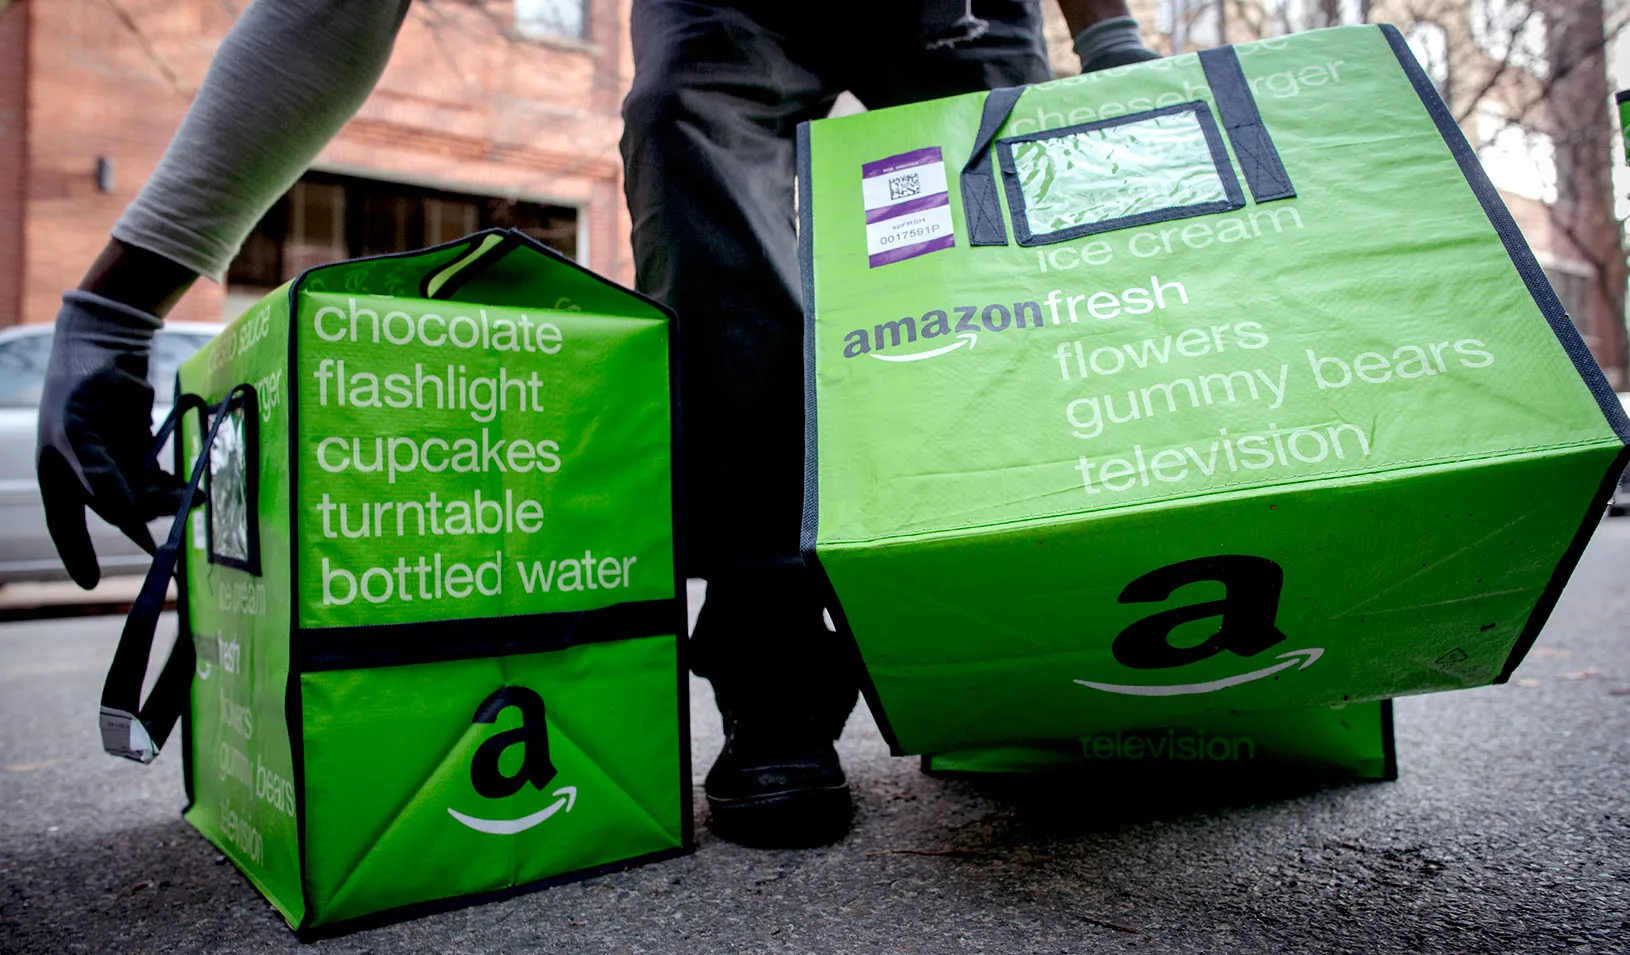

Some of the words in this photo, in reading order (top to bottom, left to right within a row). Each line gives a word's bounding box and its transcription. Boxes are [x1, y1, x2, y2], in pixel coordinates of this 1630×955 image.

[1009, 58, 1344, 137] cheesebrger
[880, 224, 941, 246] 0017591P
[1036, 239, 1113, 273] ice
[1129, 204, 1304, 258] cream
[313, 298, 563, 356] chocolate
[1053, 320, 1270, 382] flowers
[313, 358, 544, 423] flashlight
[1065, 367, 1290, 441] gummy
[1305, 338, 1496, 391] bears
[315, 427, 562, 484] cupcakes
[1074, 424, 1371, 496] television
[315, 488, 545, 540] turntable
[320, 551, 503, 607] bottled
[516, 549, 637, 595] water
[1079, 729, 1255, 762] television
[256, 752, 296, 818] bears
